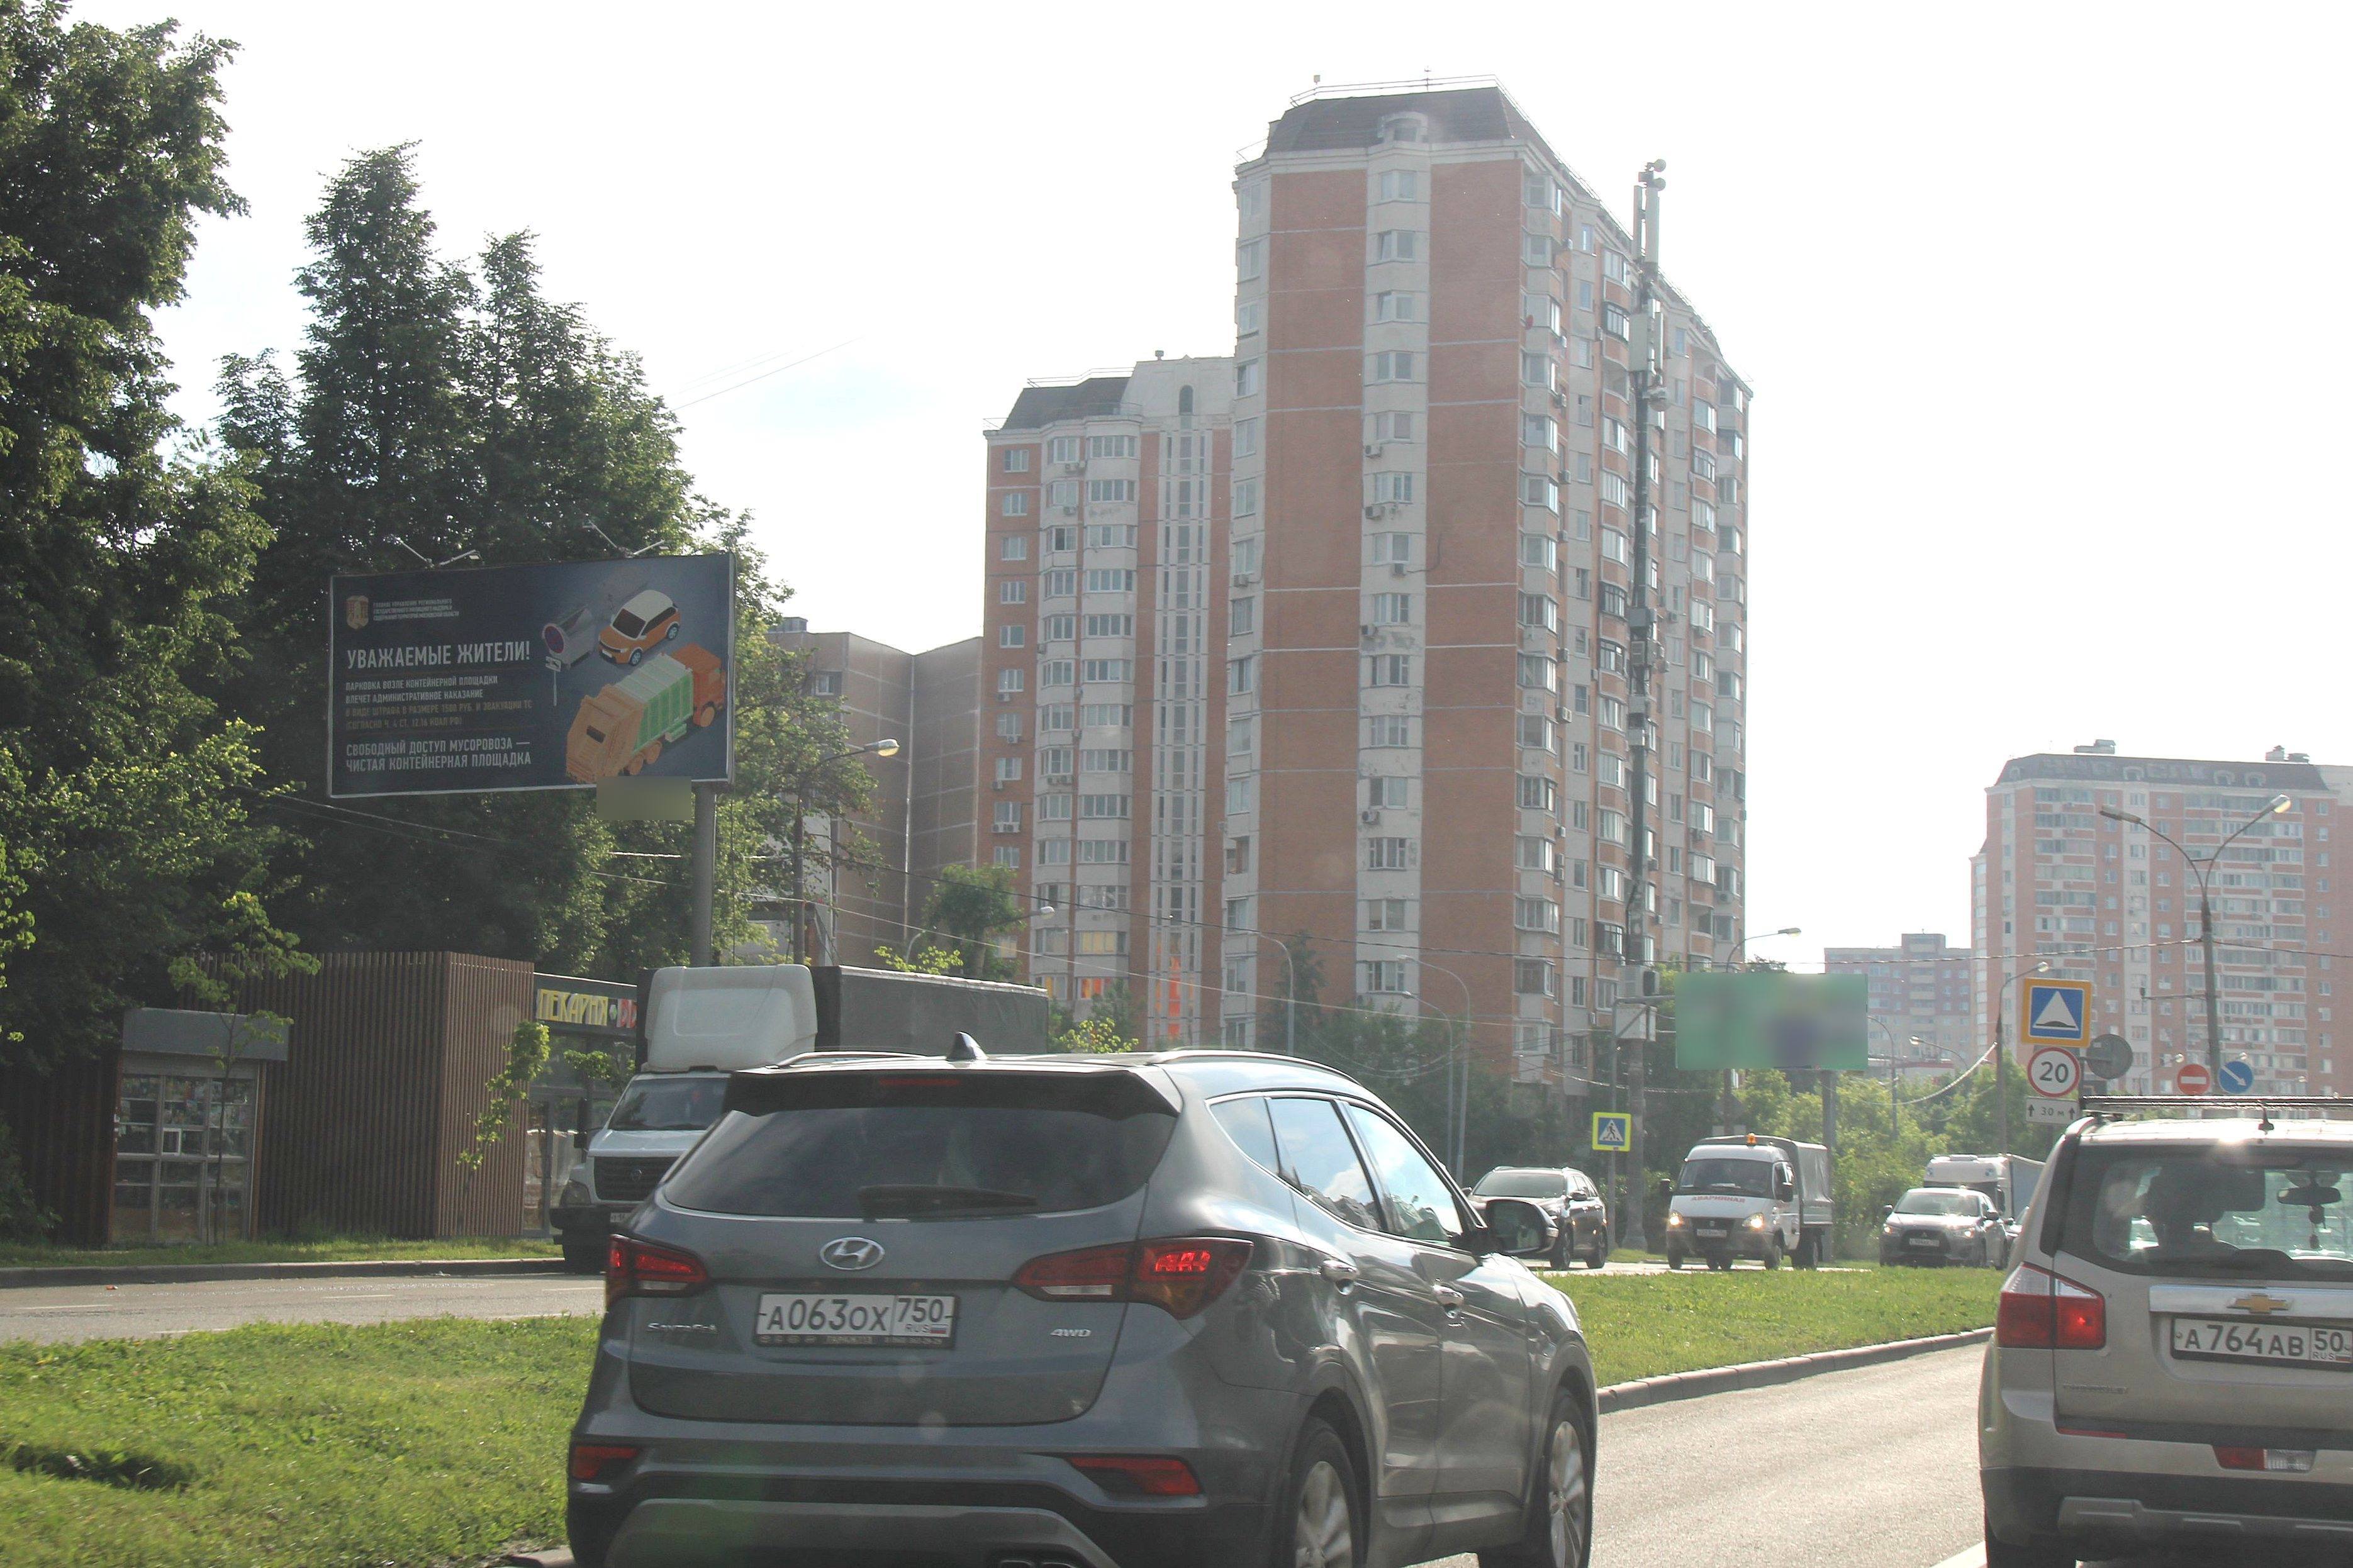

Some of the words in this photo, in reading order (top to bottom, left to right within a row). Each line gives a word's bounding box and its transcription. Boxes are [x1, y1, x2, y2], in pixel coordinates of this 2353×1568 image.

[347, 645, 451, 669] УВАЖАЕМЫЕ
[457, 640, 530, 664] ЖИТЕЛИ!
[346, 681, 381, 691] ПАРКОВКА
[383, 679, 405, 689] ВОЗЛЕ
[406, 676, 457, 688] КОНТЕЙНЕРНОЙ
[459, 676, 498, 686] ПЛОЩАДКИ
[346, 694, 371, 704] ВЛЕЧЕТ
[372, 691, 442, 703] АДМИНИСТРАТИВНОЕ
[444, 689, 483, 699] НАКАЗАНИЕ
[347, 740, 406, 756] СВОБОДНЫЙ
[409, 740, 446, 755] ДОСТУП
[450, 737, 513, 752] МУСОРОВОЗА
[346, 758, 386, 772] ЧИСТАЯ
[389, 753, 467, 770] КОНТЕЙНЕРНАЯ
[472, 752, 531, 767] ПЛОЩАДКА
[537, 989, 608, 1026] ПЕКАРНЯ
[2040, 1061, 2069, 1083] 20
[2041, 1107, 2054, 1116] 30
[906, 1323, 930, 1333] RUS
[1050, 1328, 1092, 1337] 4WD
[2312, 1352, 2335, 1361] RUS
